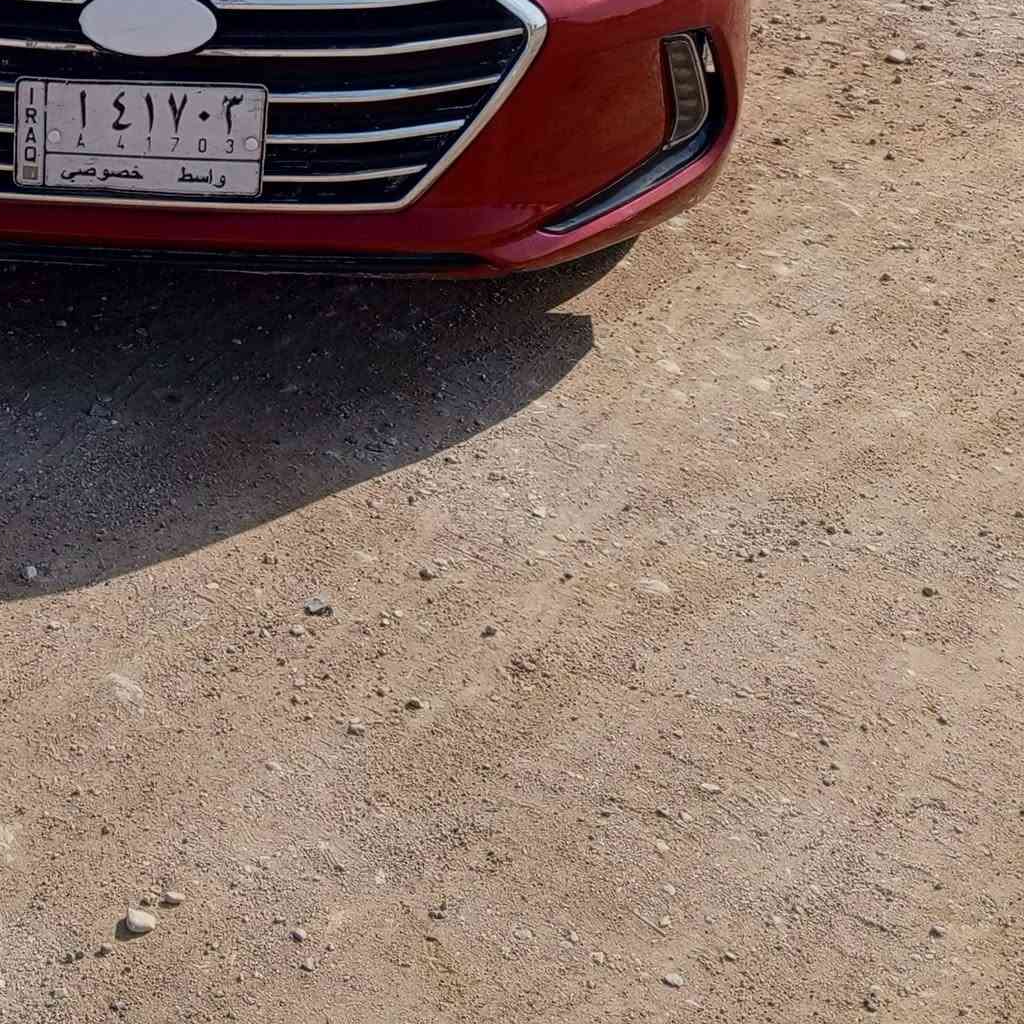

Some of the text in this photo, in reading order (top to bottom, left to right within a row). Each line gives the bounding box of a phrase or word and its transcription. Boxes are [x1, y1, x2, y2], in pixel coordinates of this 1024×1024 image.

[24, 87, 38, 163] IRAQ
[60, 164, 226, 189] واسط خصوصي
